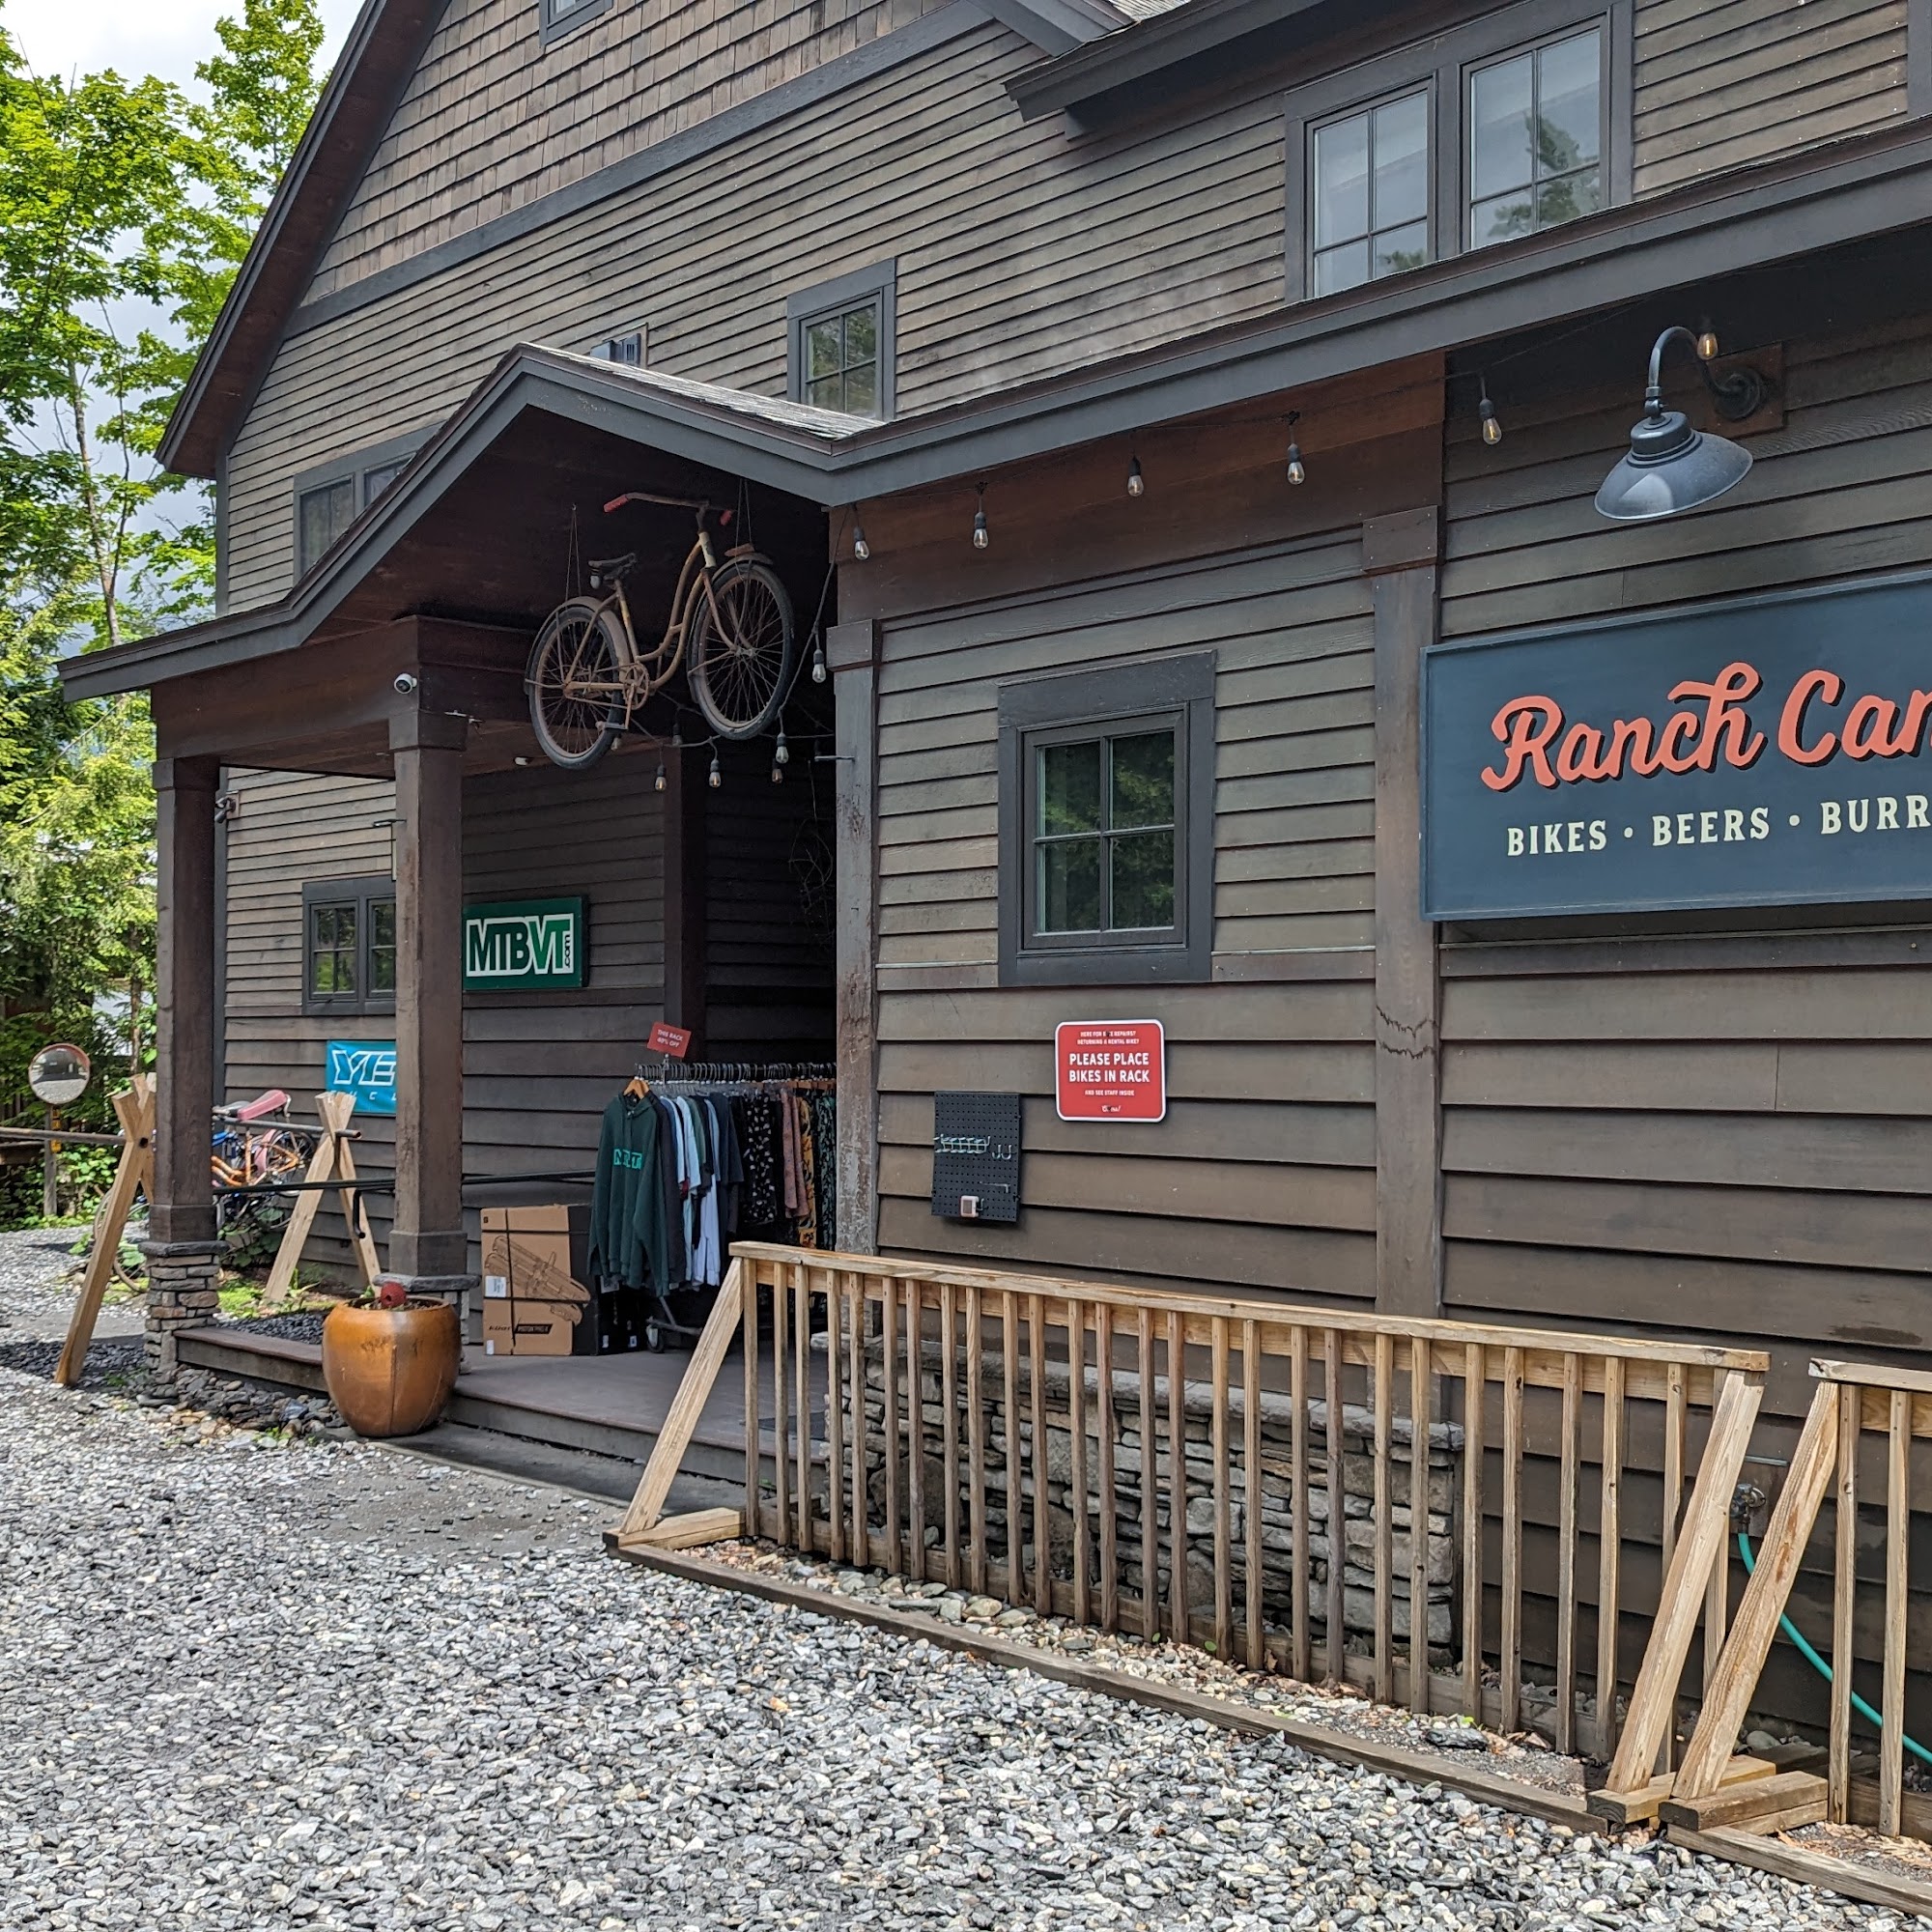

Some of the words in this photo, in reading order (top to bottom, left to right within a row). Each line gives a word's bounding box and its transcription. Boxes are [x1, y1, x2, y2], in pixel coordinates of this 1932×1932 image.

[1481, 662, 1768, 791] Ranch
[1507, 819, 1607, 857] BIKES
[1652, 807, 1770, 846] BEERS
[1820, 794, 1932, 835] BURR
[468, 916, 572, 975] MTBVT
[1068, 1053, 1110, 1065] PLEASE
[1113, 1052, 1150, 1065] PLACE
[1068, 1069, 1101, 1082] BIKES
[1104, 1069, 1116, 1082] IN
[1120, 1069, 1151, 1082] RACK
